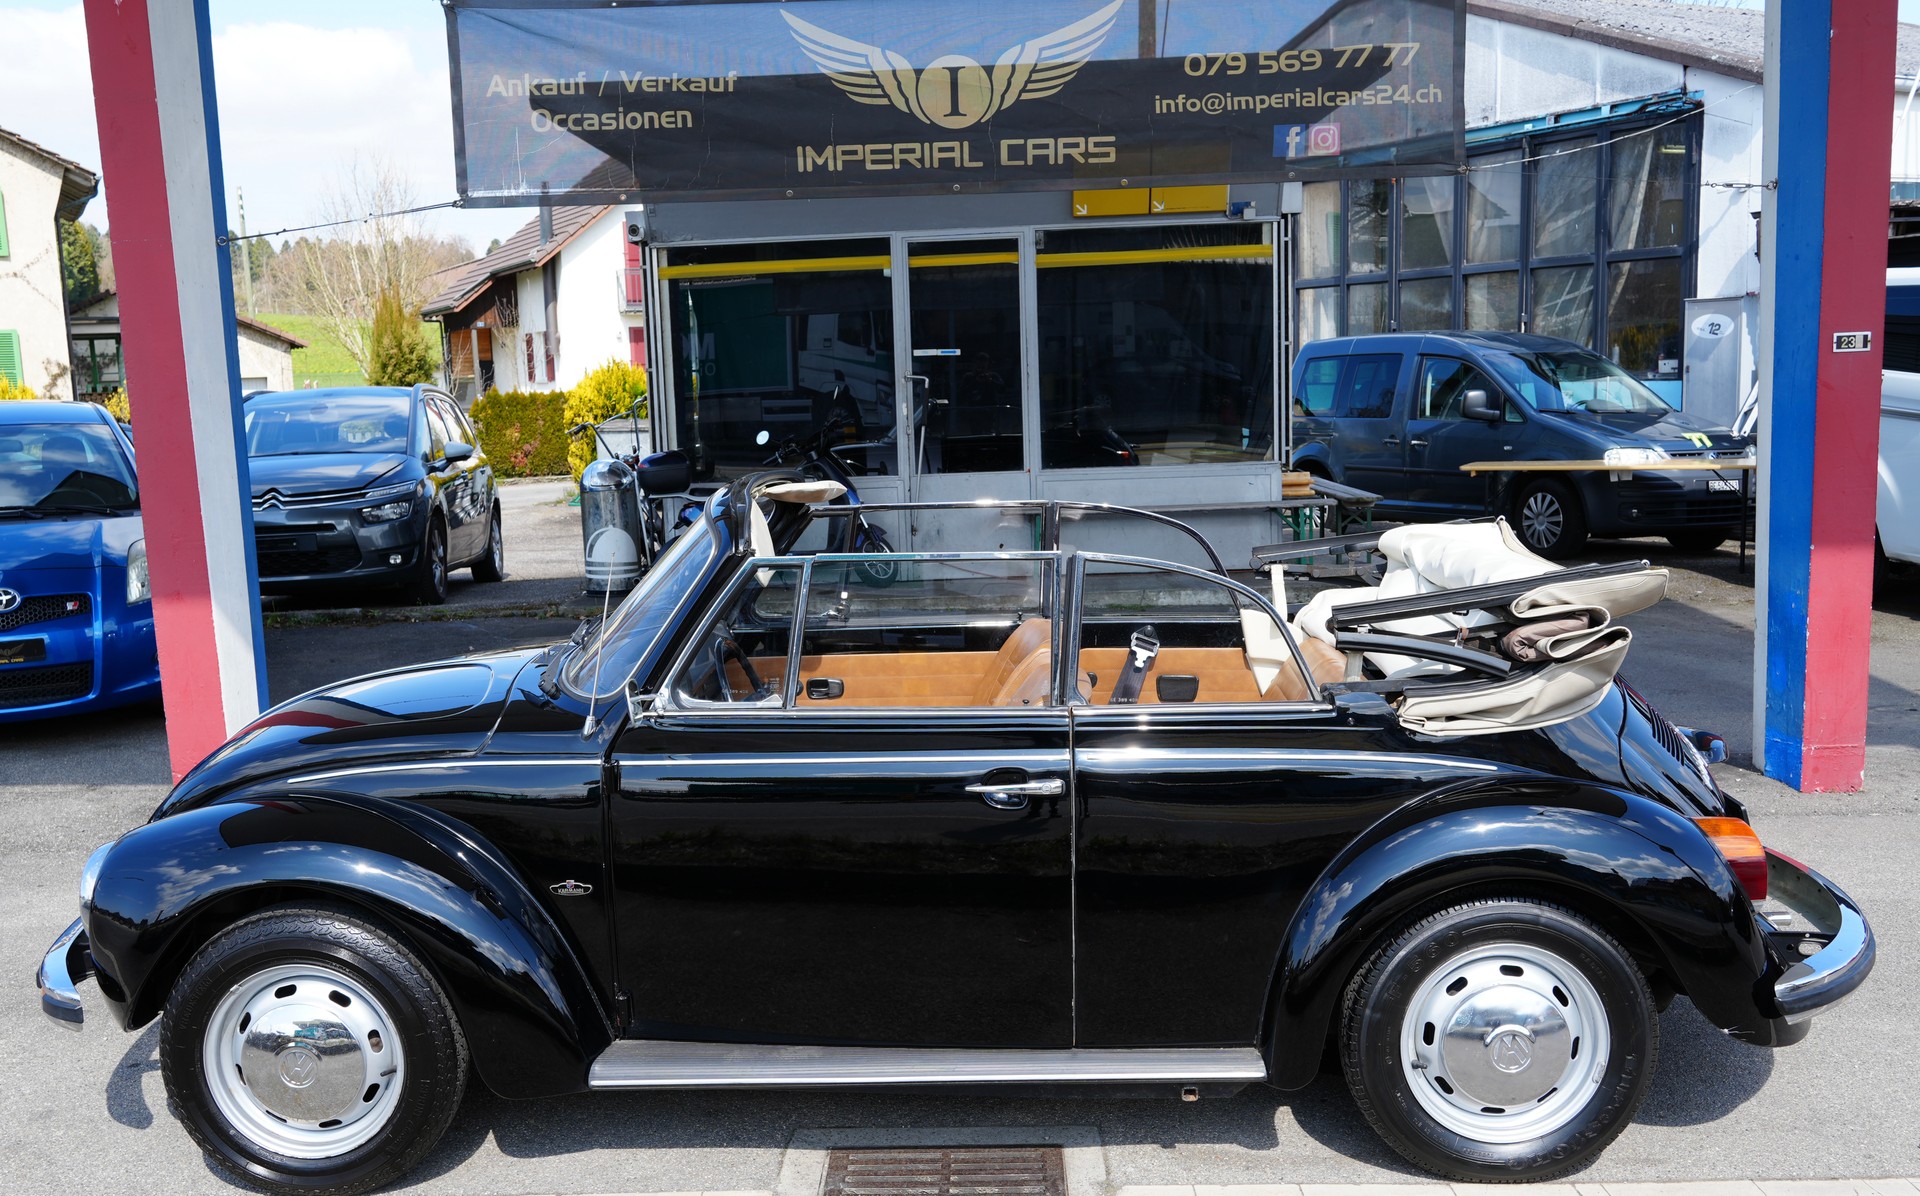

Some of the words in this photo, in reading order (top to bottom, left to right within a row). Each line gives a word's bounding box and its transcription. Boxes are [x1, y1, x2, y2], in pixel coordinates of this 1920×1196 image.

[1184, 51, 1247, 77] 079
[1258, 49, 1323, 74] 569
[1333, 44, 1372, 69] 77
[1383, 42, 1421, 67] 77
[486, 71, 586, 98] Ankauf
[619, 70, 738, 94] Verkauf
[1155, 82, 1443, 115] info@imperialcars24.ch
[530, 106, 693, 133] Occasionen
[797, 141, 984, 173] IMPERIAL
[1000, 135, 1116, 167] CARS
[1708, 322, 1721, 336] 12
[1841, 336, 1856, 349] 23
